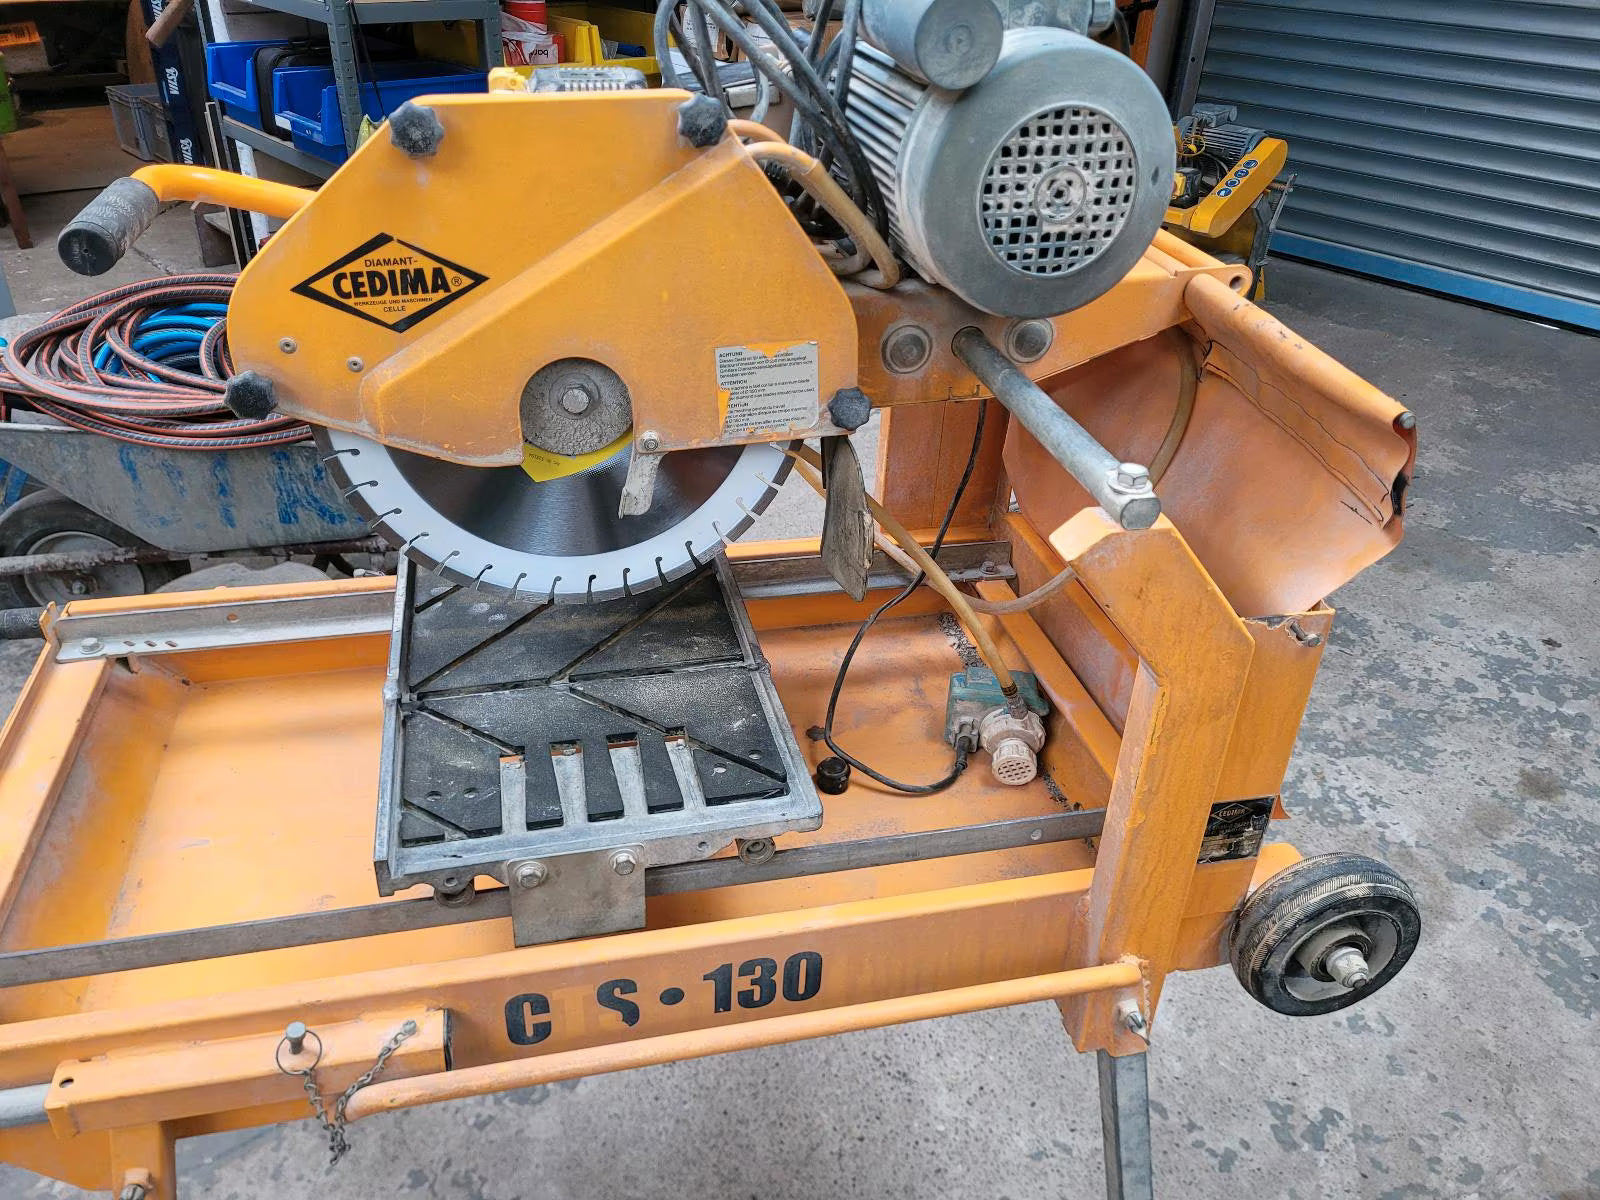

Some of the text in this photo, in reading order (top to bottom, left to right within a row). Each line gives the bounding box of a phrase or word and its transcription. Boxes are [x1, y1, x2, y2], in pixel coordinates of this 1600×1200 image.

[165, 66, 180, 95] VILSA
[364, 256, 418, 268] DIAMANT-
[383, 305, 406, 313] CELLE
[702, 950, 824, 1014] 130
